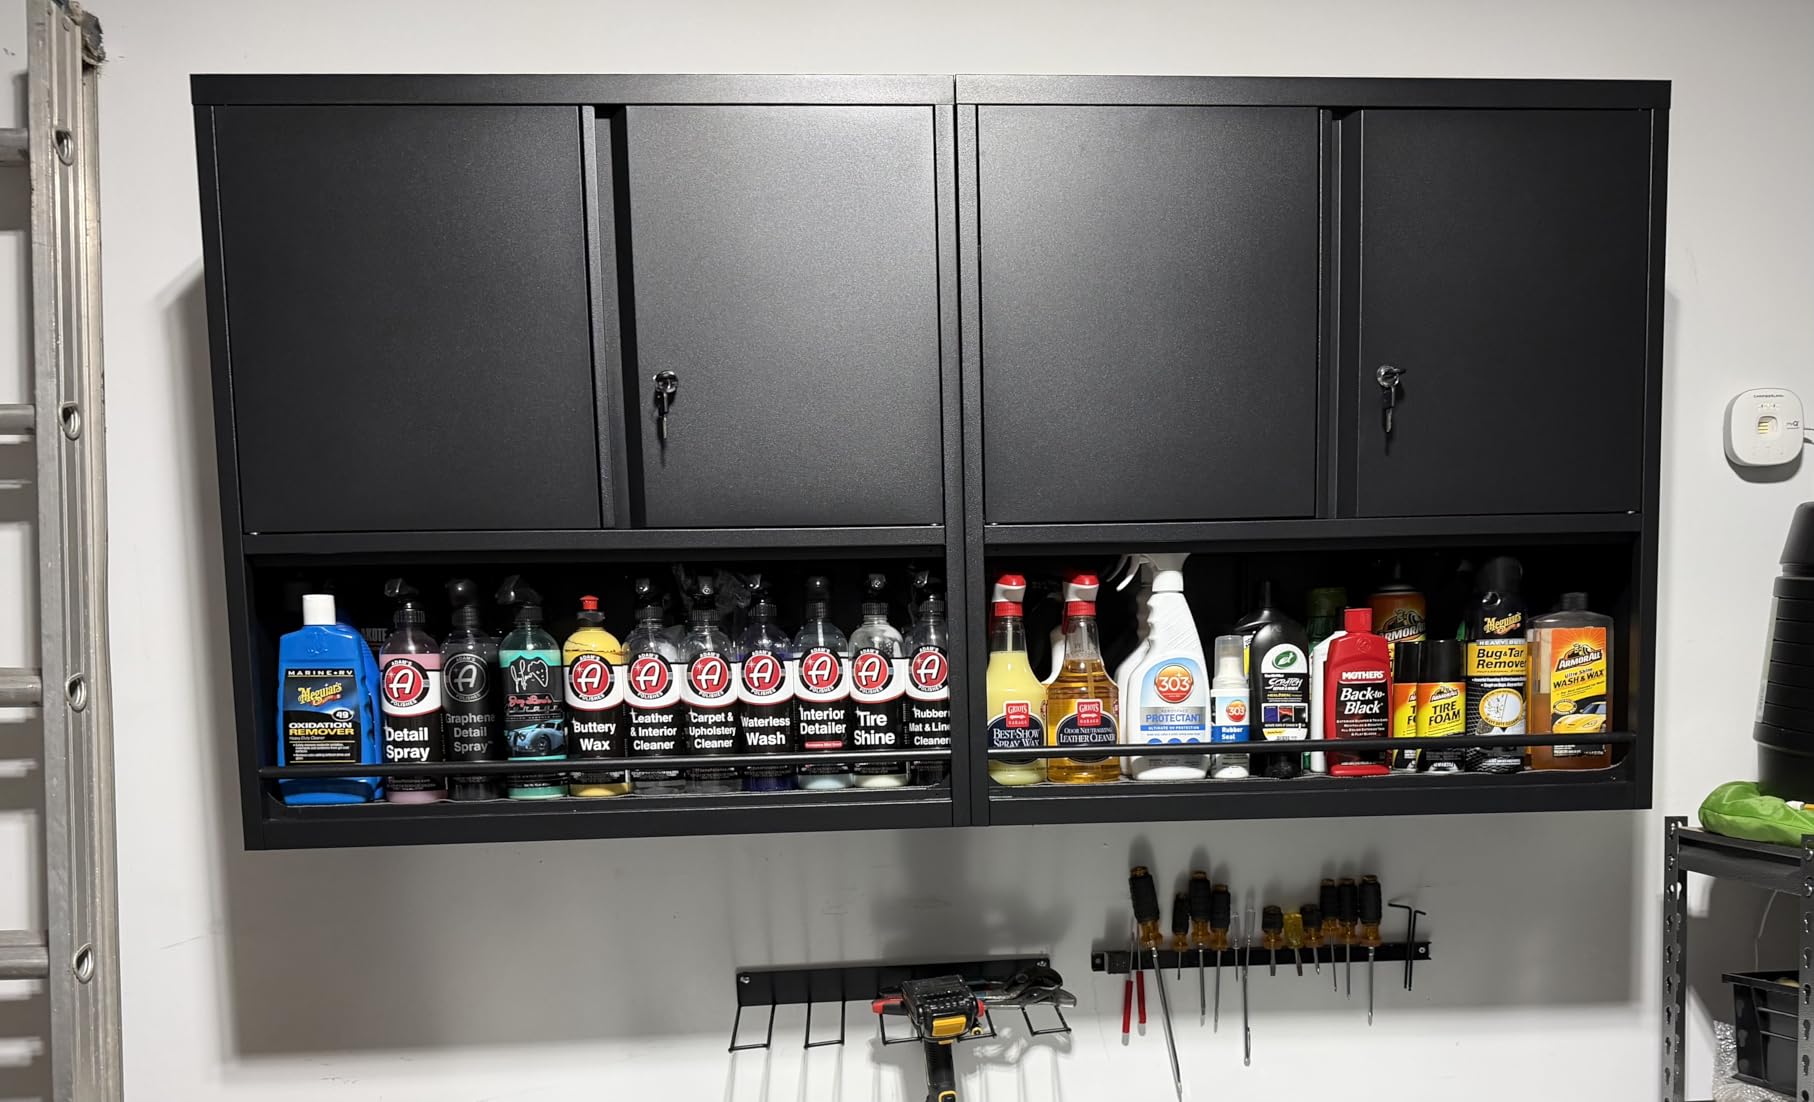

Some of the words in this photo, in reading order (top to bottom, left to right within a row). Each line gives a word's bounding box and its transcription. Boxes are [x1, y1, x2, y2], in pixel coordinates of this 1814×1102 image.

[1342, 671, 1385, 680] MOTHERS
[1553, 675, 1579, 689] WASH
[1586, 669, 1605, 680] WAX
[1158, 676, 1190, 692] 303
[298, 682, 342, 705] Meguiar's
[914, 709, 947, 718] Rubber
[1228, 706, 1245, 716] 303
[1344, 700, 1381, 715] Black
[1432, 701, 1457, 715] TIRE
[335, 711, 349, 719] 49
[445, 713, 495, 726] Graphene
[632, 712, 674, 724] Leather
[691, 712, 726, 724] Carpet
[727, 712, 734, 722] &
[800, 707, 845, 721] Interior
[859, 711, 888, 727] Tire
[1429, 709, 1461, 726] FOAM
[741, 716, 791, 727] Waterless
[909, 722, 923, 732] Mat
[924, 723, 931, 732] &
[289, 728, 354, 736] REMOVER
[385, 727, 429, 741] Detail
[453, 727, 487, 738] Detail
[573, 721, 616, 735] Buttery
[630, 727, 637, 737] &
[638, 726, 677, 737] Interior
[689, 726, 736, 738] Upholstery
[800, 722, 847, 735] Detailer
[694, 738, 733, 749] Cleaner
[746, 731, 786, 746] Wash
[854, 730, 896, 745] Shine
[914, 736, 948, 746] Cleaner
[993, 739, 1021, 748] SPRAY
[1021, 738, 1040, 747] WAX
[1060, 734, 1090, 743] LEATHER
[580, 738, 611, 751] Wax
[633, 739, 675, 751] Cleaner
[386, 745, 430, 762] Spray
